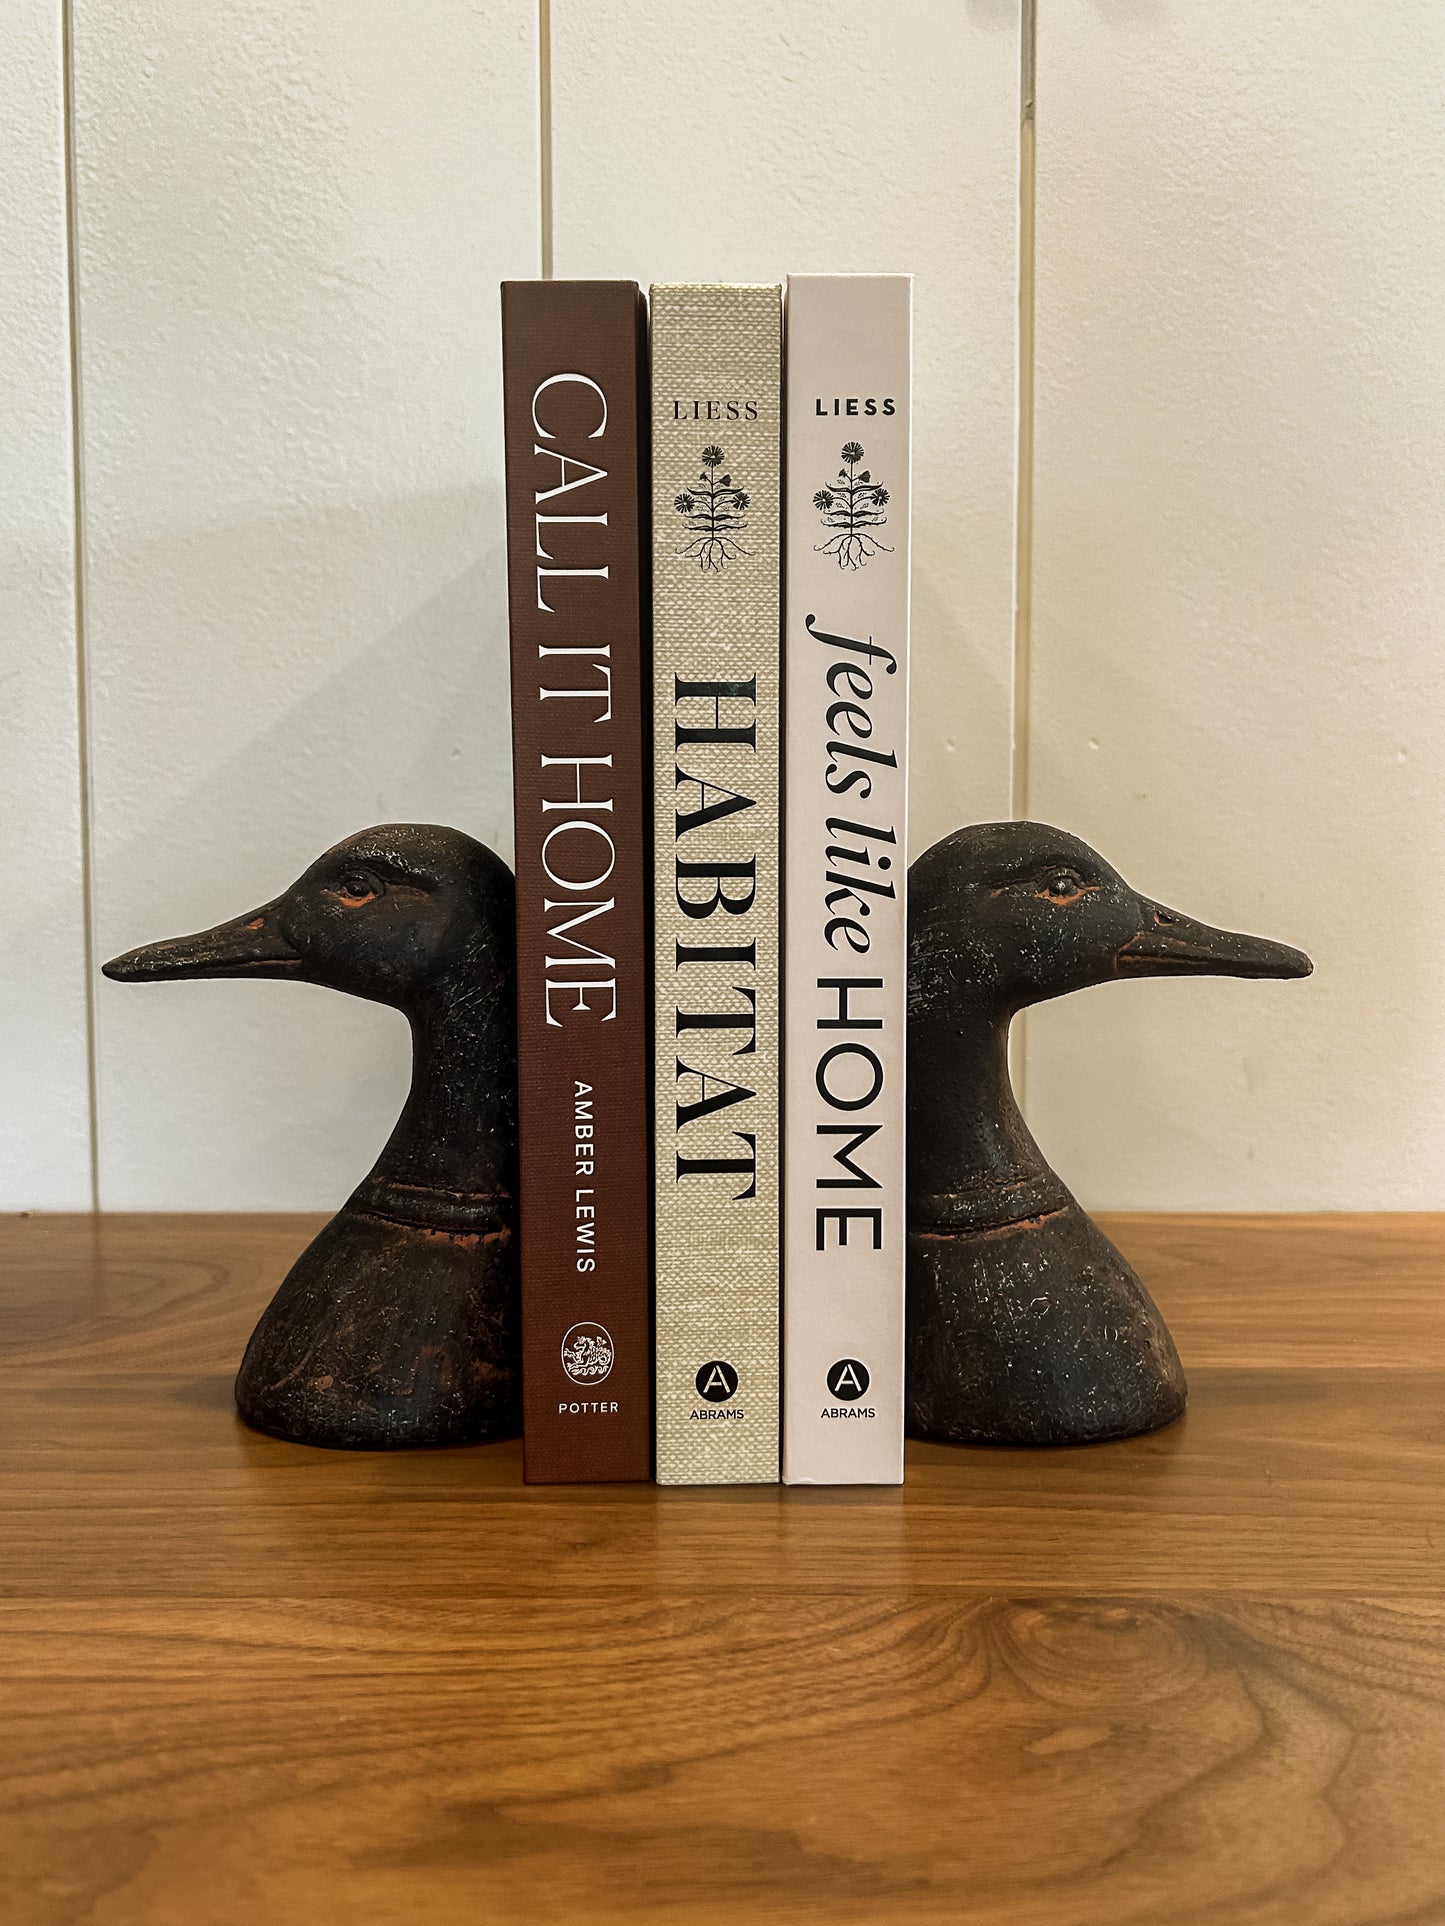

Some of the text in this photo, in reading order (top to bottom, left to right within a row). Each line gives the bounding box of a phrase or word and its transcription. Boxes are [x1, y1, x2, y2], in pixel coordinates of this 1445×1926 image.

[673, 400, 758, 421] LIESS
[815, 398, 896, 416] LIESS
[531, 373, 617, 1028] CALL IT HOME
[674, 671, 757, 1201] HABITAT
[805, 613, 898, 1251] feels like HOME
[574, 1080, 596, 1273] AMBER LEWIS
[558, 1401, 619, 1415] POTTER
[689, 1409, 745, 1421] ABRAMS
[820, 1407, 876, 1420] ABRAMS
